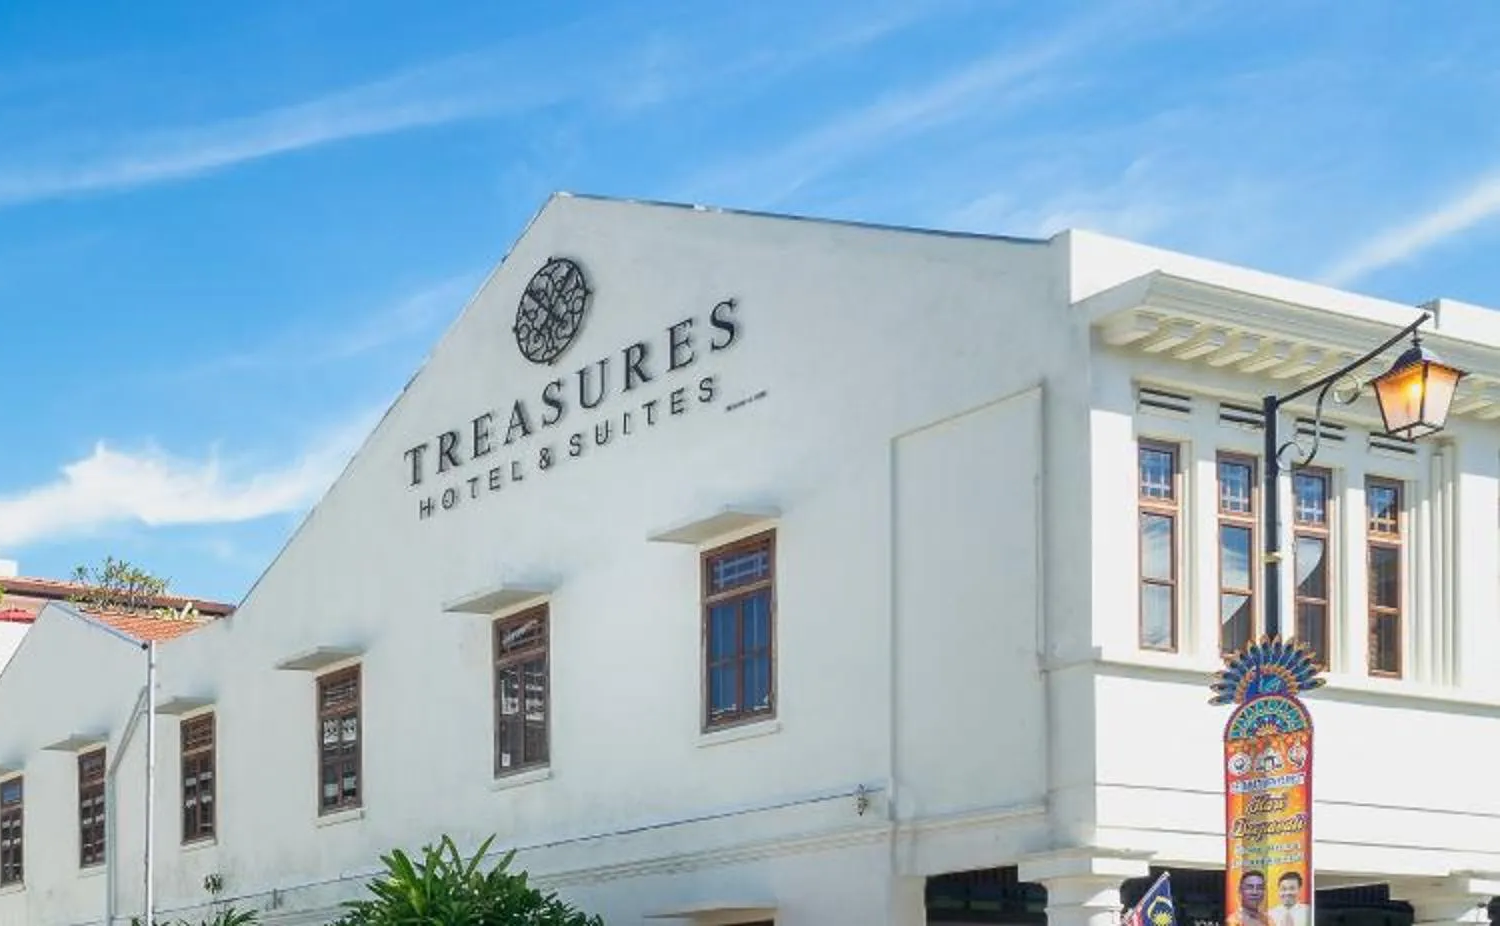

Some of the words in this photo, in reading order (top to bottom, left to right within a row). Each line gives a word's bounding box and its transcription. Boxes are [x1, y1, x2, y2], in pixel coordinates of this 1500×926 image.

[403, 297, 740, 488] TREASURES
[418, 461, 524, 521] HOTEL
[538, 446, 554, 472] &
[568, 376, 716, 458] SUITES
